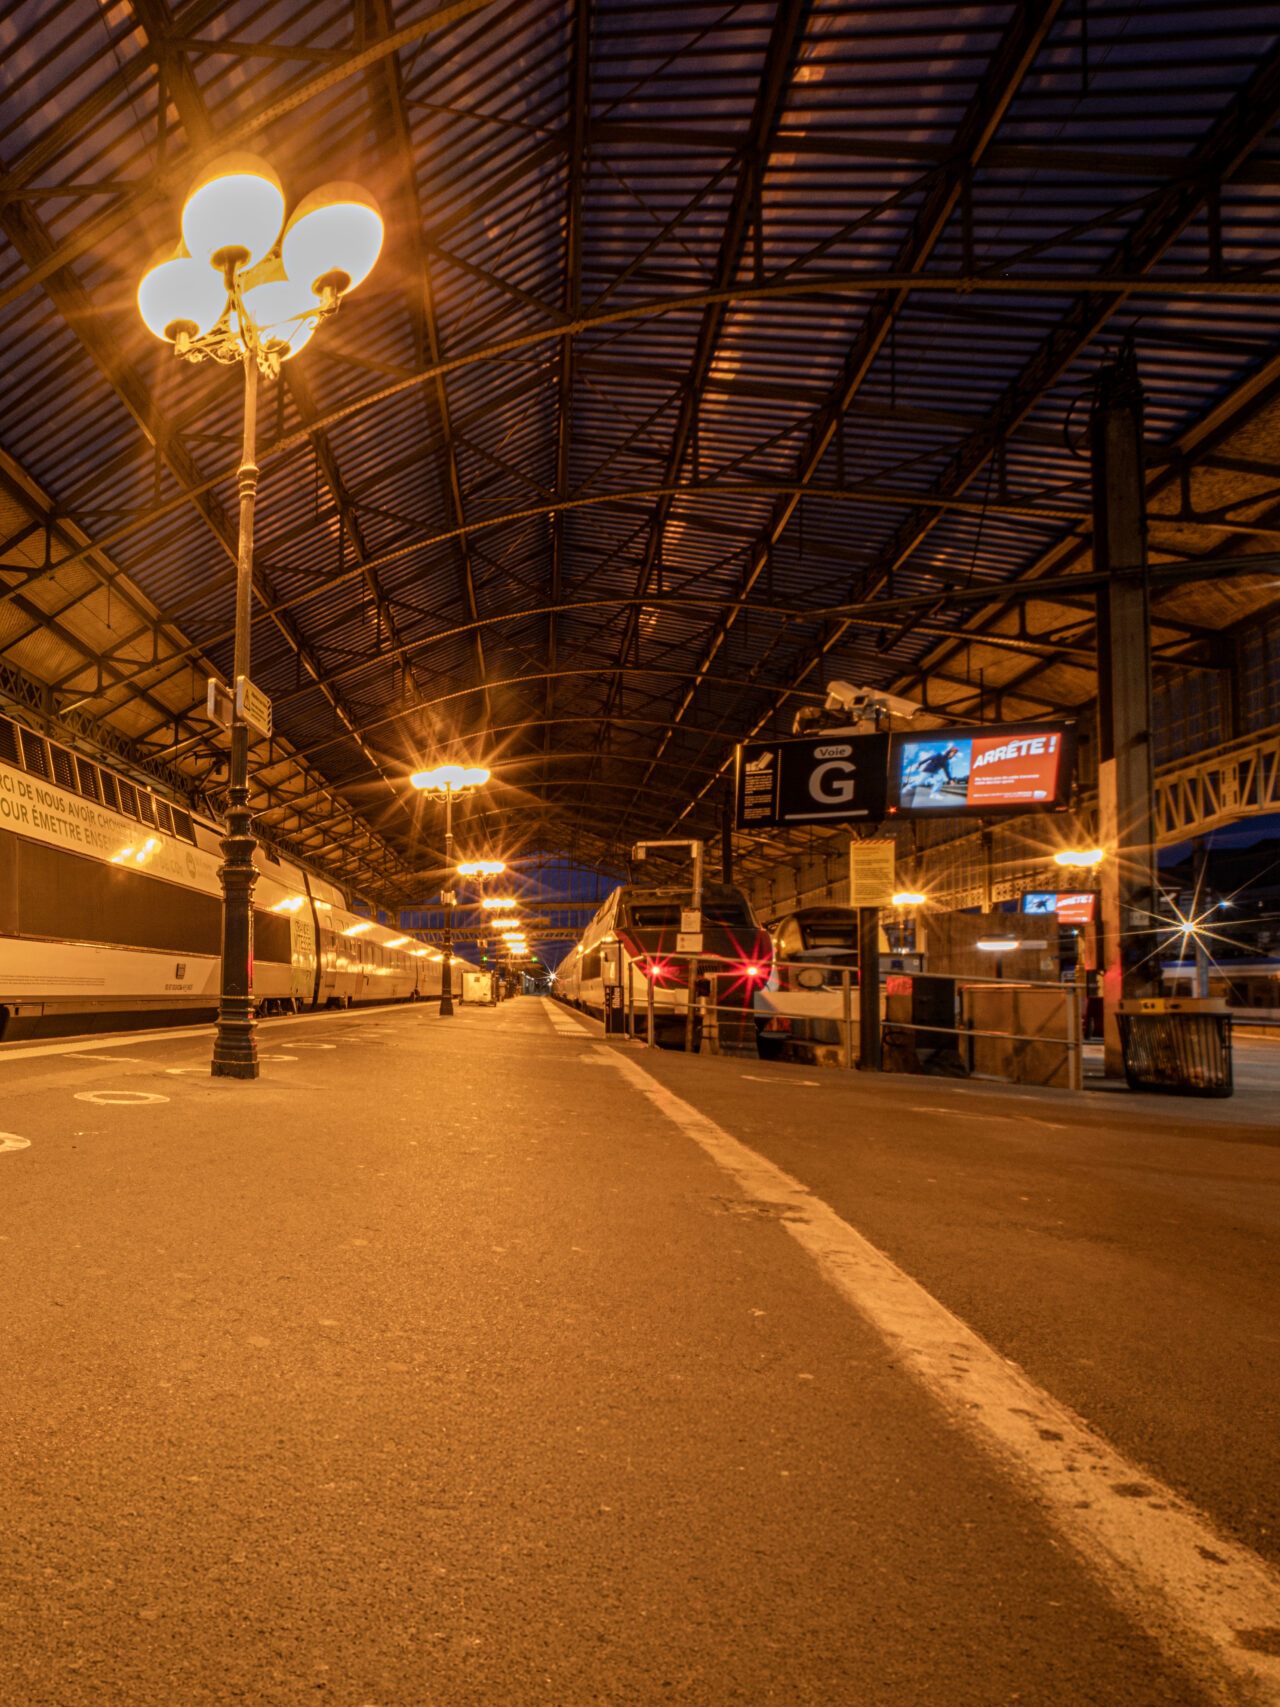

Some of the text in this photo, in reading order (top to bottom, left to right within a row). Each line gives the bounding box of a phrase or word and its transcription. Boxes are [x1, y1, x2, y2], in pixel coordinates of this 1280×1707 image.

[820, 748, 846, 757] Voie
[972, 737, 1047, 769] ARRÊTE
[808, 760, 857, 804] G
[18, 780, 34, 801] DE
[36, 787, 66, 813] NOUS
[68, 801, 96, 826] AVOIR
[32, 804, 83, 842] ÉMETTRE
